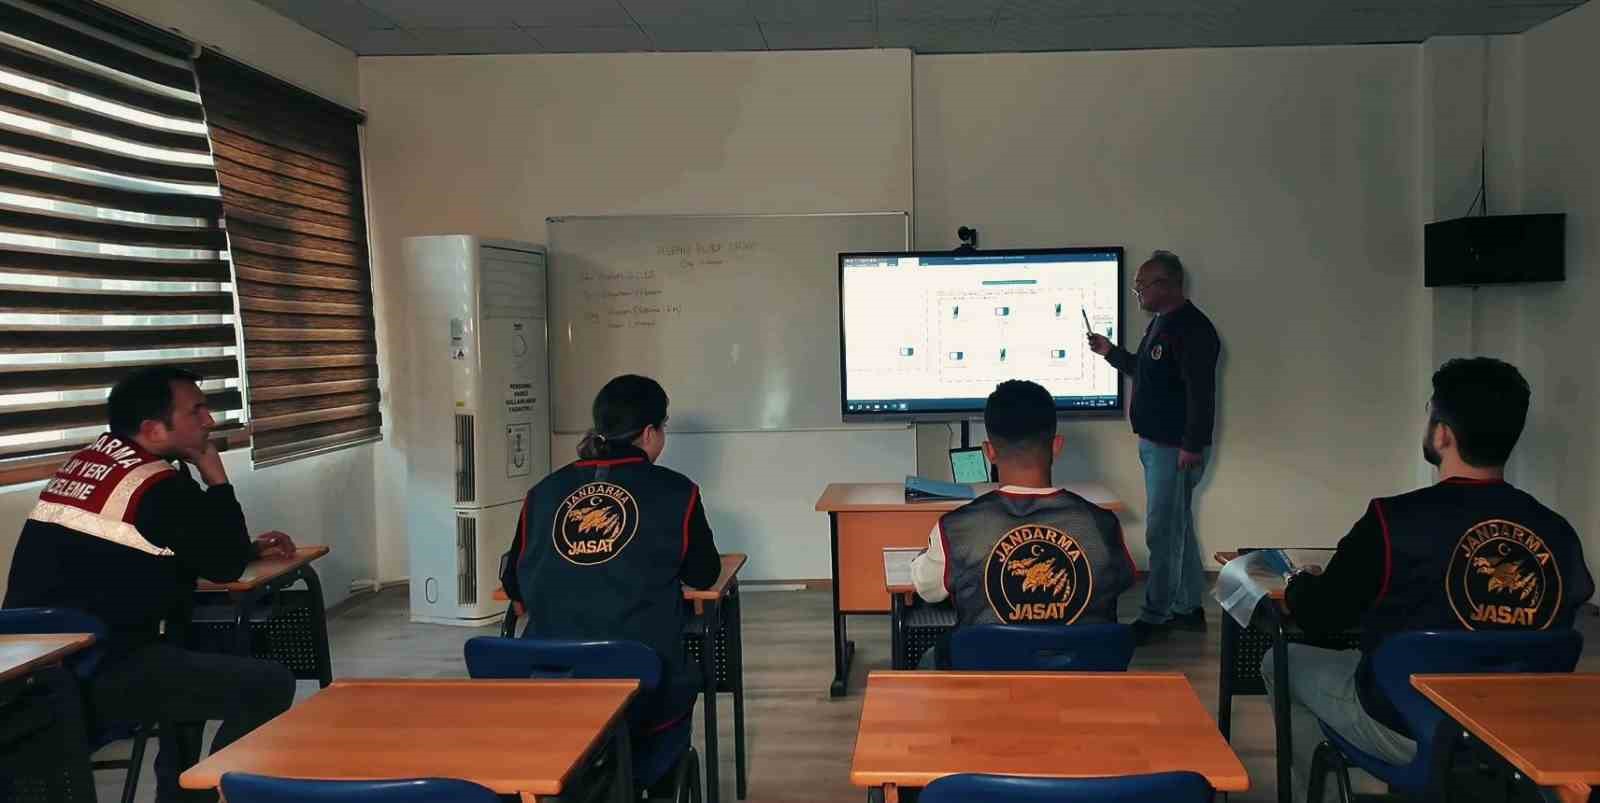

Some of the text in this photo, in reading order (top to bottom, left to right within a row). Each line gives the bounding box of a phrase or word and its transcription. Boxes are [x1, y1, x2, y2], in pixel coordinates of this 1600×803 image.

[567, 485, 629, 509] JANDARMA
[568, 539, 614, 555] JASAT
[995, 528, 1080, 562] JANDARMA
[1461, 524, 1549, 567] JANDARMA
[1010, 603, 1066, 621] JASAT
[1472, 604, 1537, 625] JASAT
